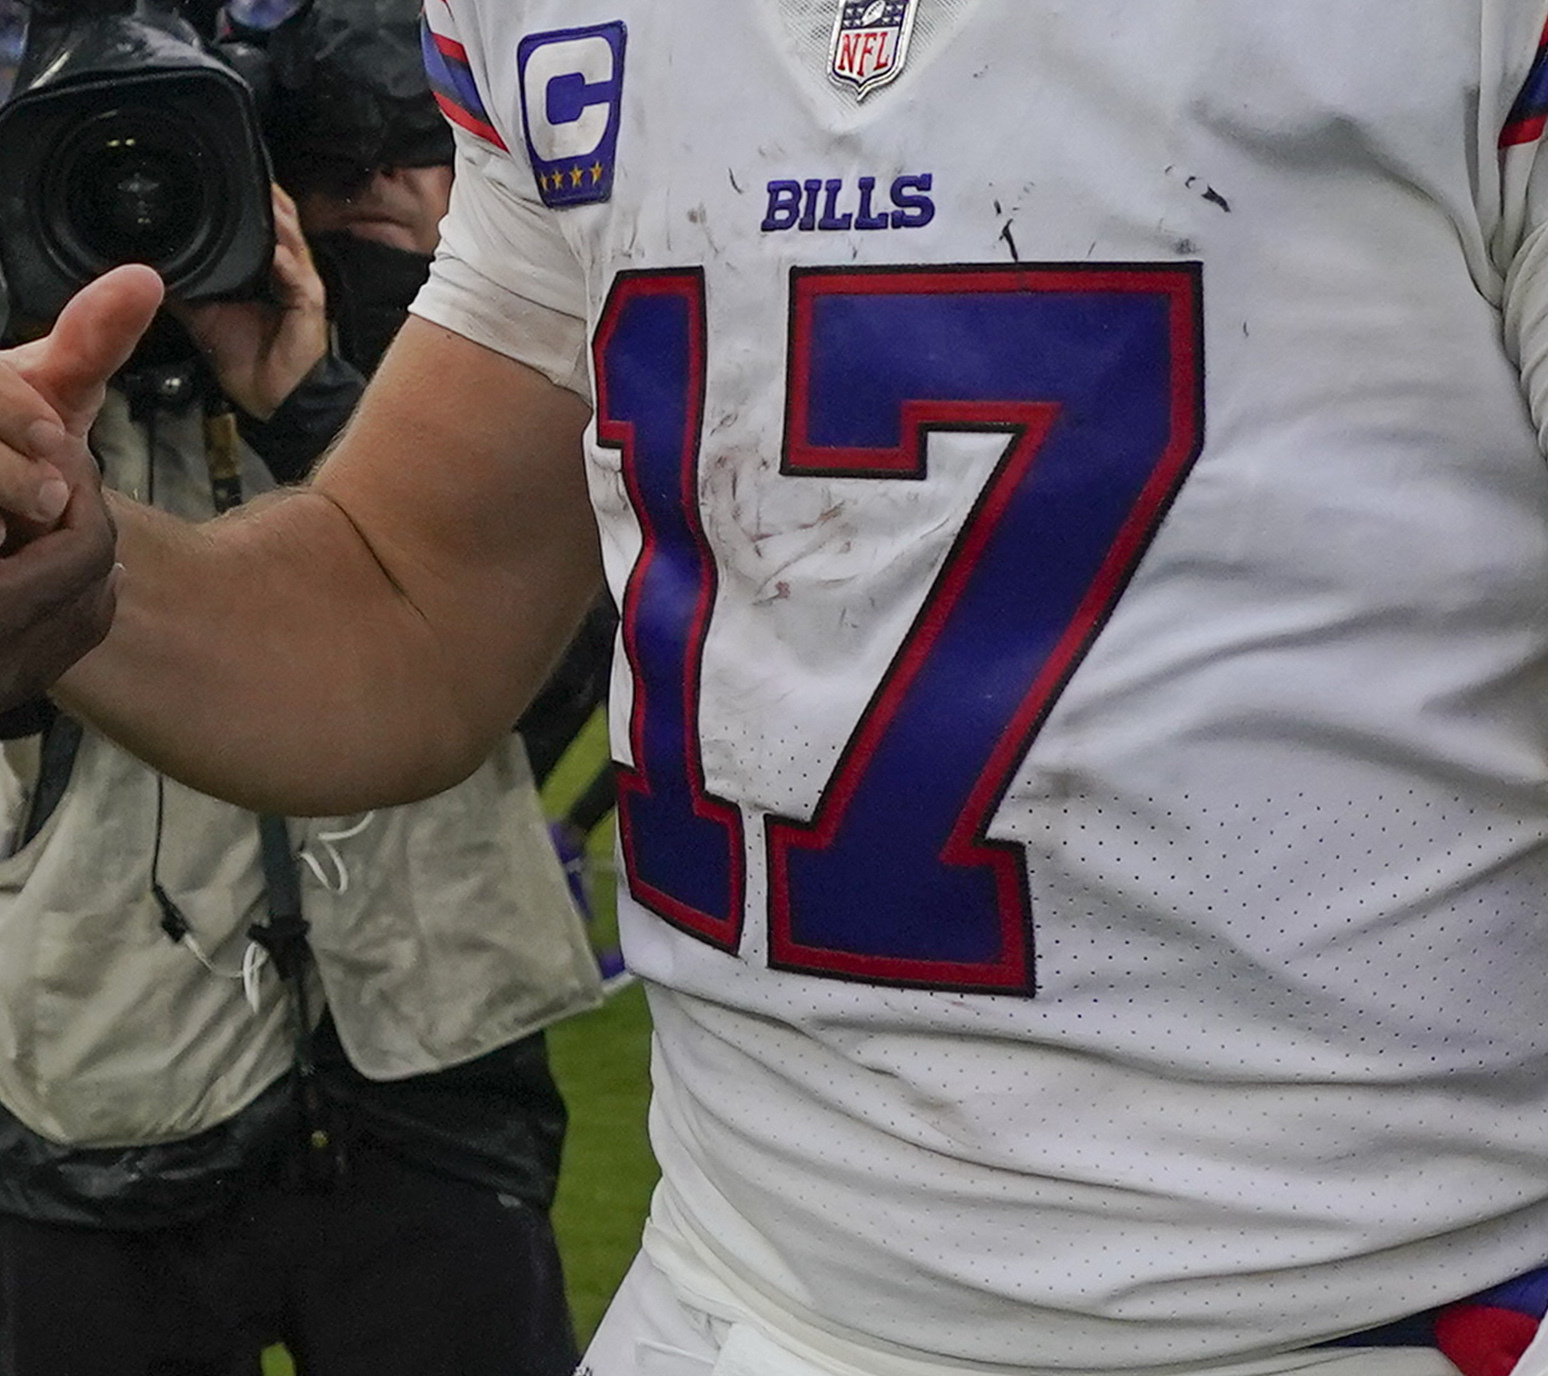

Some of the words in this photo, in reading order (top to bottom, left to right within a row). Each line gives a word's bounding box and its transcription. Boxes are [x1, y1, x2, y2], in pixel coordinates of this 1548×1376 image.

[522, 36, 614, 161] C
[837, 31, 892, 75] NFL
[760, 173, 935, 233] BILLS
[591, 260, 1206, 999] 17
